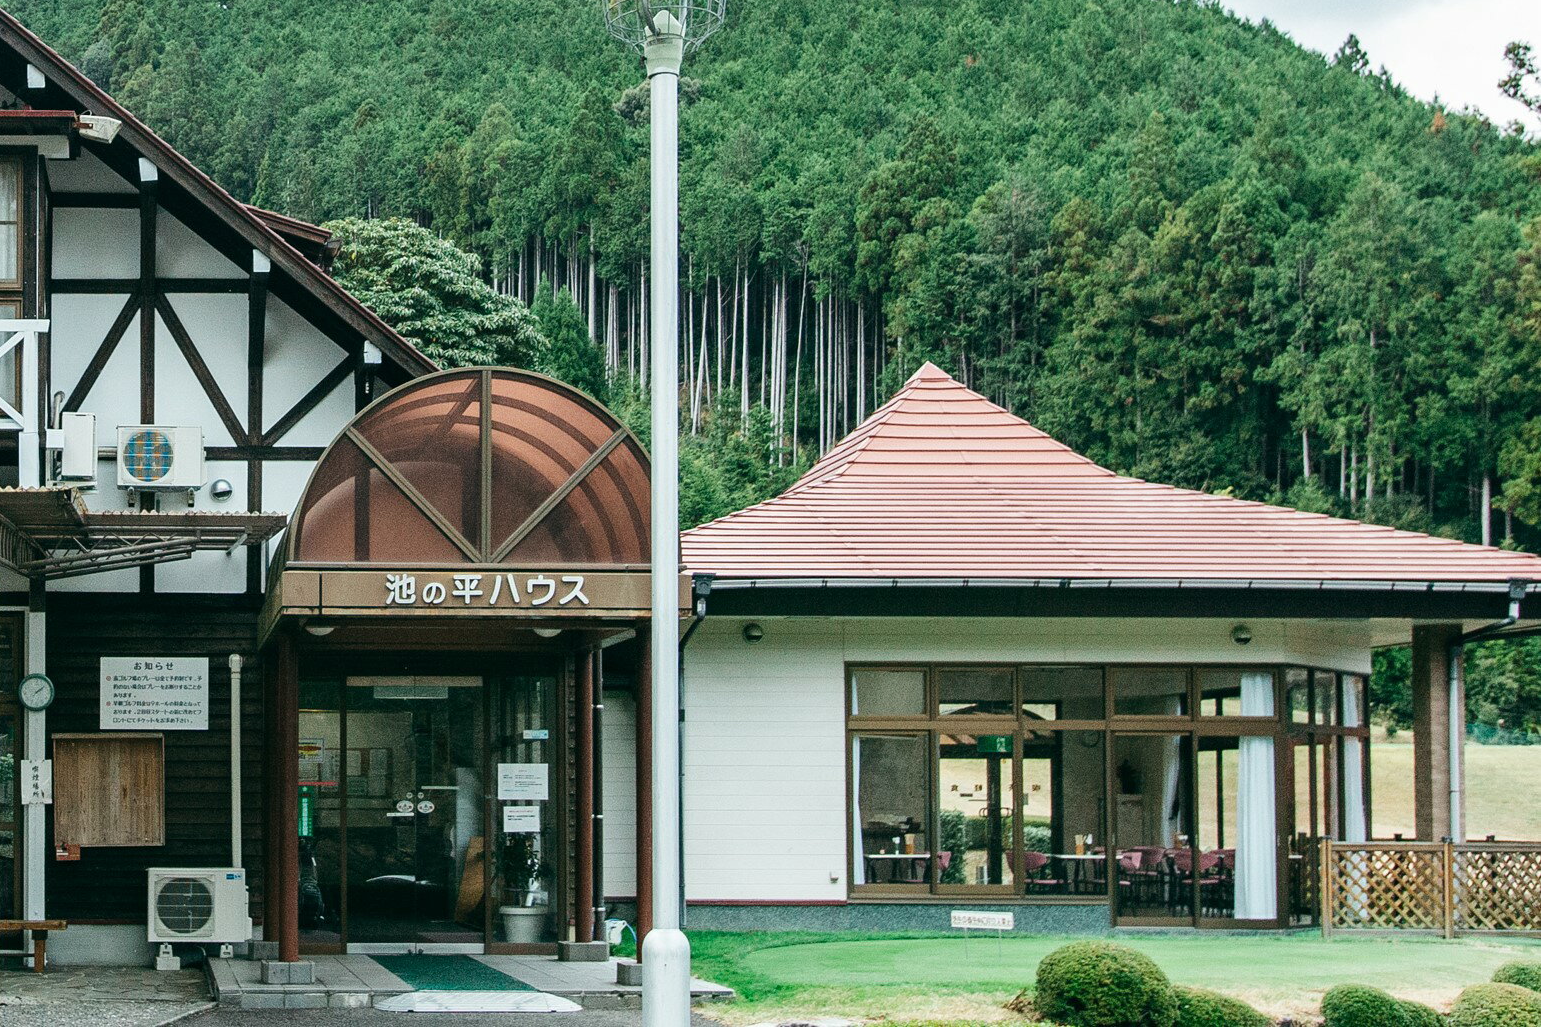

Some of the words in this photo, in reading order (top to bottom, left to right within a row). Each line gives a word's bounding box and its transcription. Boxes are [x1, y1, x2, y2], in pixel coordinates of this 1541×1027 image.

[385, 574, 589, 605] 池の平ハウス
[133, 662, 174, 670] お知らせ
